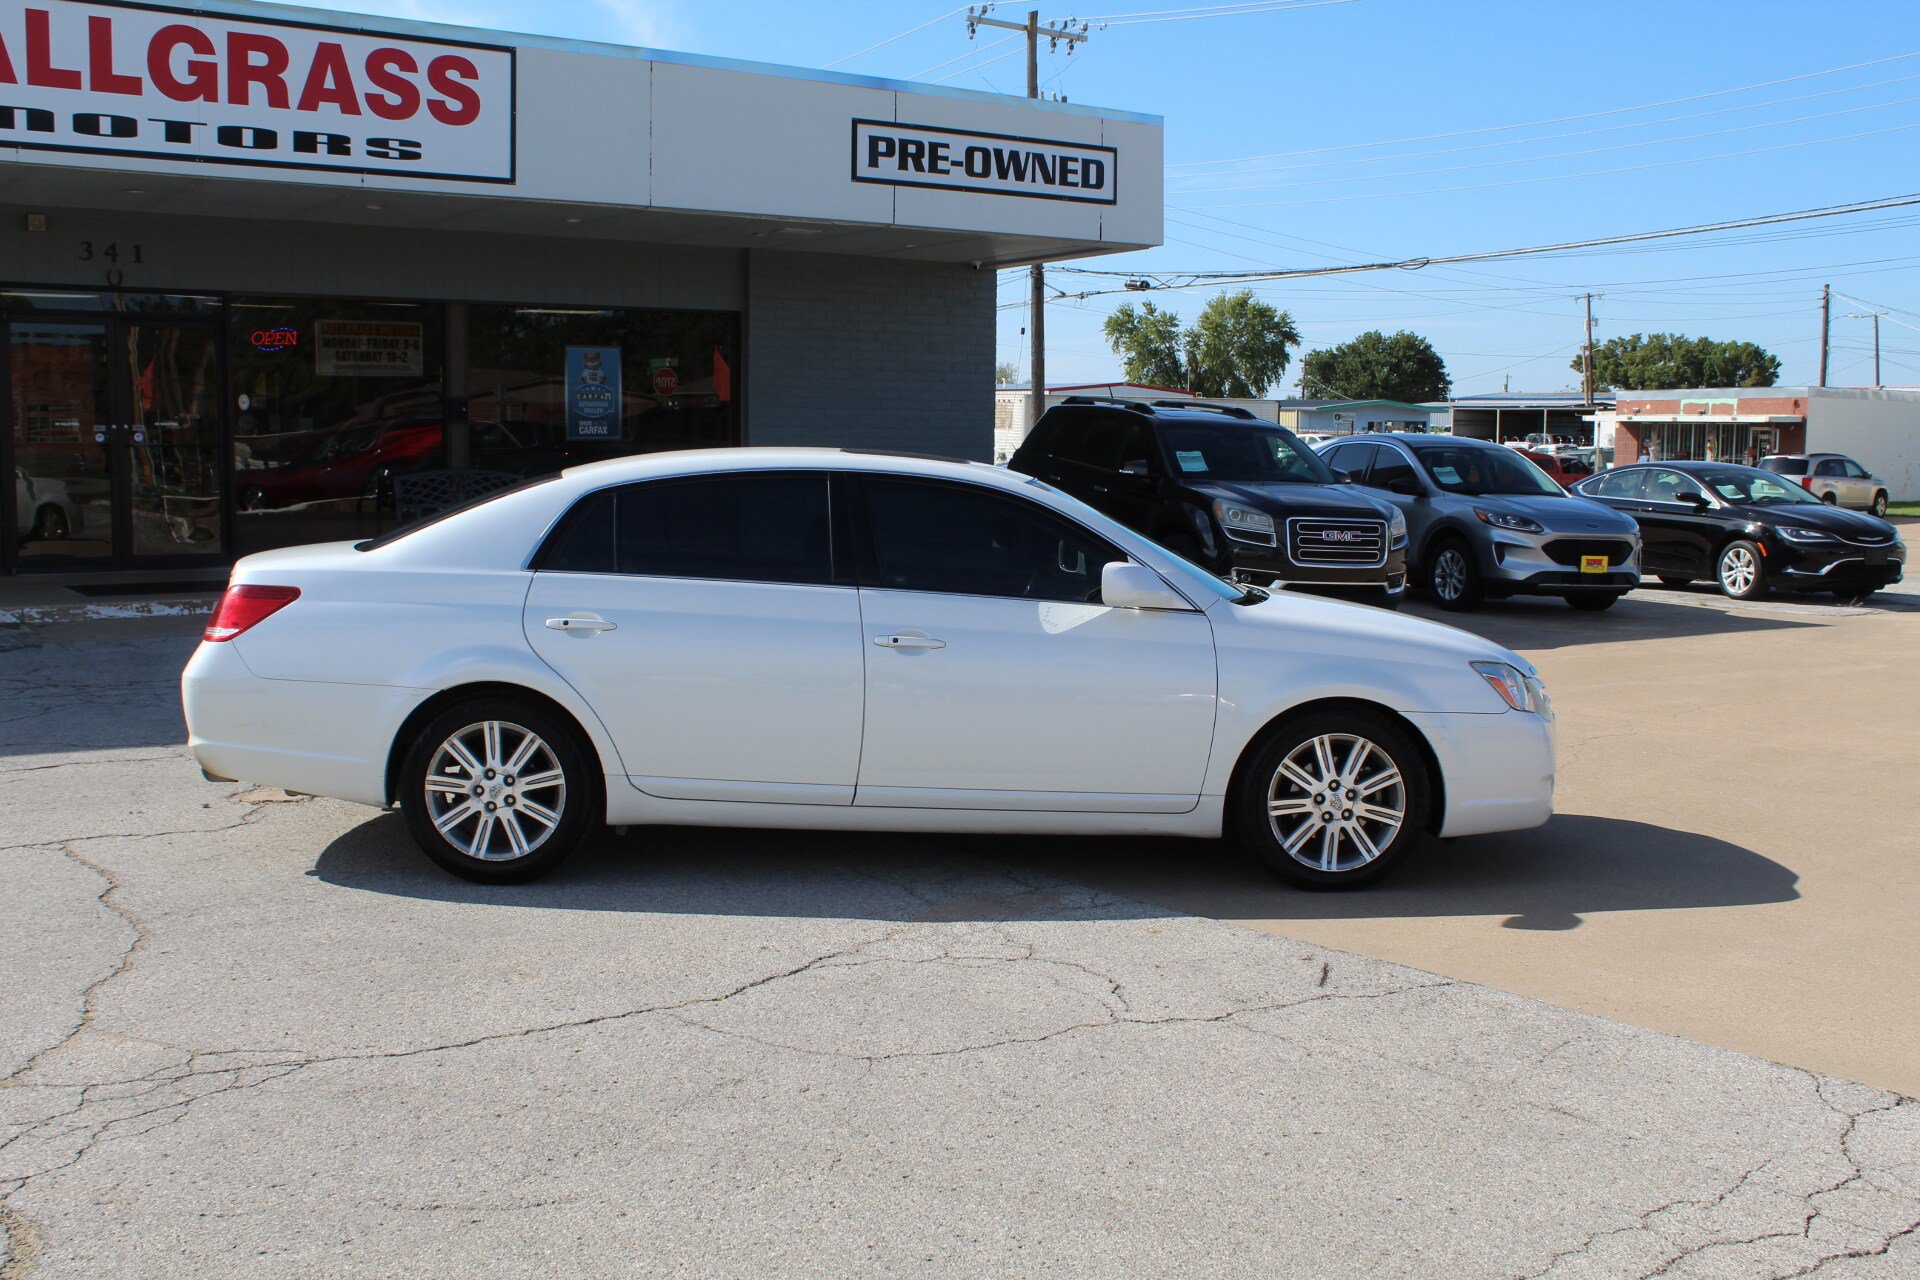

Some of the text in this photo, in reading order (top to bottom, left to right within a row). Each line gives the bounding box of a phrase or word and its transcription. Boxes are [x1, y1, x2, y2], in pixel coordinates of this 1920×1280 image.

[0, 8, 481, 126] LLGRASS
[868, 134, 1105, 190] PRE-OWNED
[78, 241, 144, 264] 341
[251, 331, 299, 346] OPEN
[335, 350, 383, 362] SATURDAY
[579, 426, 609, 435] CARFAX
[1322, 530, 1362, 542] GMC
